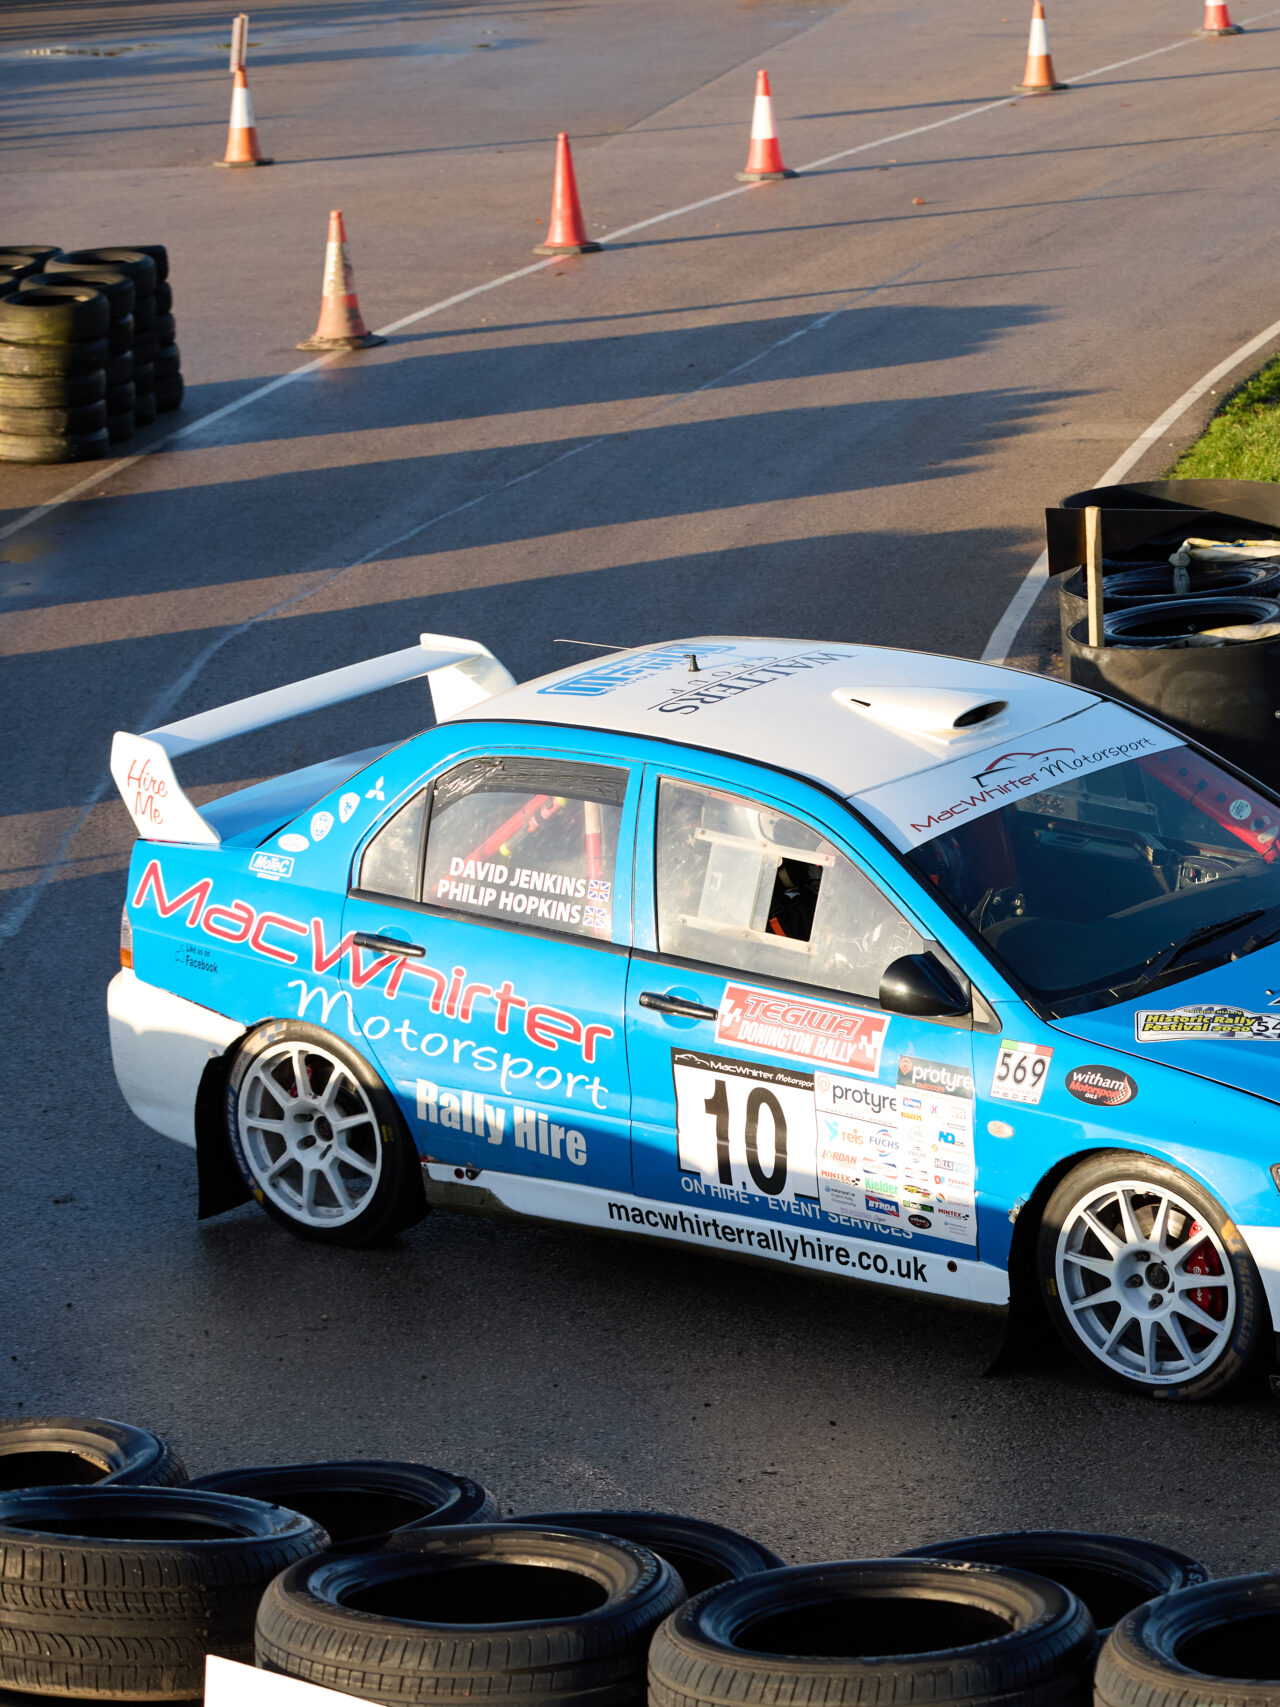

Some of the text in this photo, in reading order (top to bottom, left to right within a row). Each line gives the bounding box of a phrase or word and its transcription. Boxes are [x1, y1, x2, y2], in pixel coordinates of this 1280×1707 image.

[658, 650, 857, 715] WALTERS
[670, 656, 779, 695] GROUP
[127, 759, 168, 797] Hire
[910, 736, 1156, 832] MacWhirter Motorsport
[134, 791, 163, 825] Me
[253, 855, 290, 873] MoTeC
[450, 856, 587, 898] DAVID JENKINS
[437, 879, 582, 924] PHILIP HOPKINS
[132, 858, 614, 1063] MacWhirter
[185, 954, 218, 973] Facebook
[745, 994, 865, 1040] TEGIWA
[1142, 1022, 1211, 1032] Festival
[1144, 1014, 1257, 1027] Historic Rally
[288, 979, 609, 1110] Motorsport
[737, 1021, 858, 1064] DONINGTON RALLY
[710, 1060, 815, 1088] MacWhirter Motorspor
[911, 1064, 974, 1092] protyre
[997, 1053, 1046, 1087] 569
[1073, 1071, 1125, 1089] witham
[832, 1084, 898, 1114] protyre
[993, 1090, 1038, 1102] MEDIA
[1085, 1092, 1098, 1100] OILS
[416, 1078, 588, 1166] Rally Hire
[704, 1079, 788, 1196] 10
[841, 1128, 864, 1146] reis
[869, 1136, 899, 1150] FUCHS
[821, 1169, 851, 1182] MINTEX
[865, 1176, 898, 1195] Kielder
[681, 1177, 705, 1196] ON
[710, 1185, 750, 1206] HIRE
[768, 1197, 821, 1221] EVENT
[867, 1199, 897, 1213] BTRDA
[608, 1199, 928, 1284] macwhirterrallyhire.co.uk
